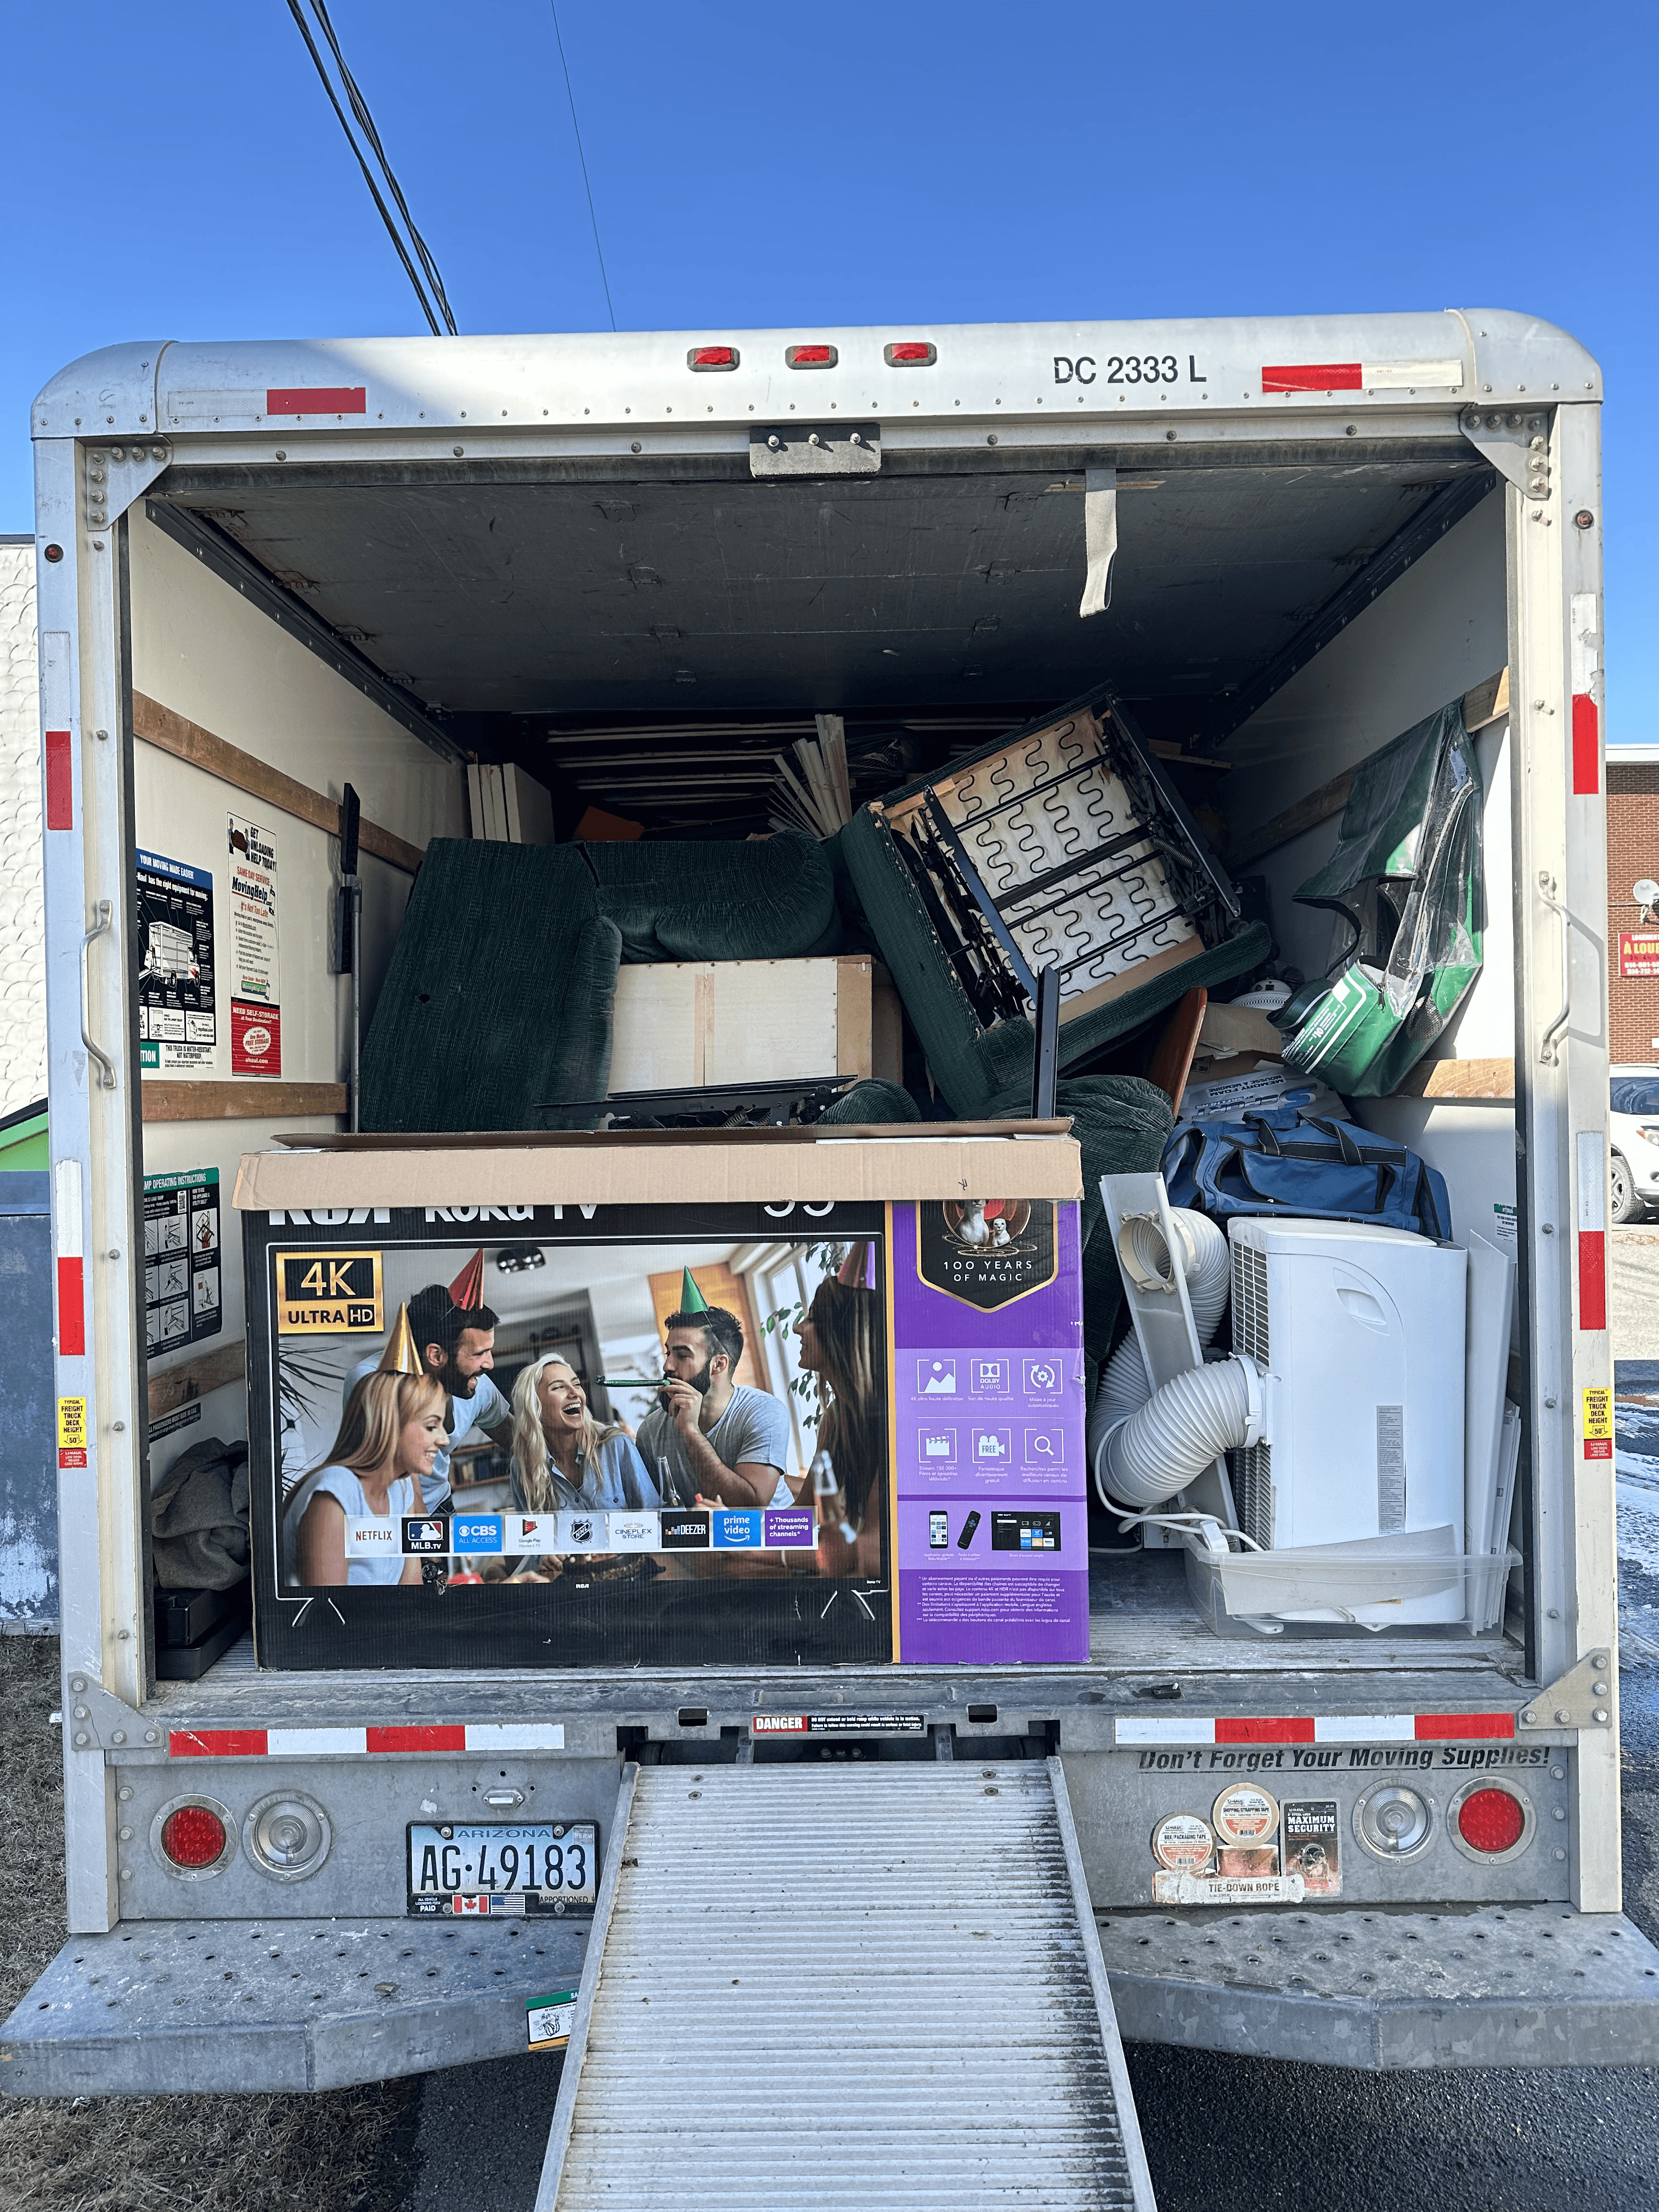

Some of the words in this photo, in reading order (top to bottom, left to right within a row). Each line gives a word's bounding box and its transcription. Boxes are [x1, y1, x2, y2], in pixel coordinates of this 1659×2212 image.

[1054, 357, 1096, 384] DC
[1108, 356, 1178, 383] 2333
[1189, 355, 1206, 382] L
[250, 826, 259, 840] GET
[250, 839, 274, 859] UNLOADING
[250, 851, 261, 865] HELP
[139, 854, 152, 866] YOUR
[153, 858, 169, 872] MOVING
[169, 864, 180, 876] MADE
[180, 867, 194, 880] EASIER
[237, 866, 248, 878] SAME
[256, 873, 270, 887] SERVICE
[261, 907, 269, 918] Late
[1624, 941, 1632, 955] À
[233, 1007, 246, 1015] NEED
[246, 1009, 279, 1020] SELF-STORAGE
[1241, 1079, 1284, 1091] MEMORY
[1210, 1088, 1239, 1097] FOAM
[1192, 1094, 1279, 1119] SPORT
[153, 1176, 177, 1189] OPERATING
[177, 1173, 206, 1186] INSTRUCTIONS
[943, 1261, 972, 1271] 100
[983, 1260, 1032, 1270] YEARS
[300, 1261, 357, 1297] 4K
[953, 1274, 970, 1282] OF
[978, 1273, 1023, 1282] MAGIC
[287, 1310, 345, 1324] ULTRA
[349, 1308, 374, 1323] HD
[982, 1445, 996, 1453] FREE
[724, 1516, 750, 1525] prime
[356, 1531, 392, 1541] NETFLIX
[470, 1525, 497, 1536] CBS
[575, 1526, 589, 1538] NHL
[680, 1525, 706, 1535] DEEZER
[724, 1526, 750, 1534] video
[411, 1542, 442, 1550] MLB.TV
[757, 1717, 803, 1730] DANGER
[1139, 1751, 1203, 1770] Don't
[1210, 1750, 1284, 1773] Forget
[1293, 1750, 1342, 1768] Your
[1349, 1748, 1433, 1770] Moving
[1442, 1747, 1550, 1769] Supplies!
[1288, 1815, 1335, 1825] MAXIMUM
[457, 1829, 551, 1838] ARIZONA
[1288, 1824, 1335, 1833] SECURITY
[1209, 1883, 1253, 1892] TIE-DOWN
[1256, 1882, 1280, 1892] ROPE
